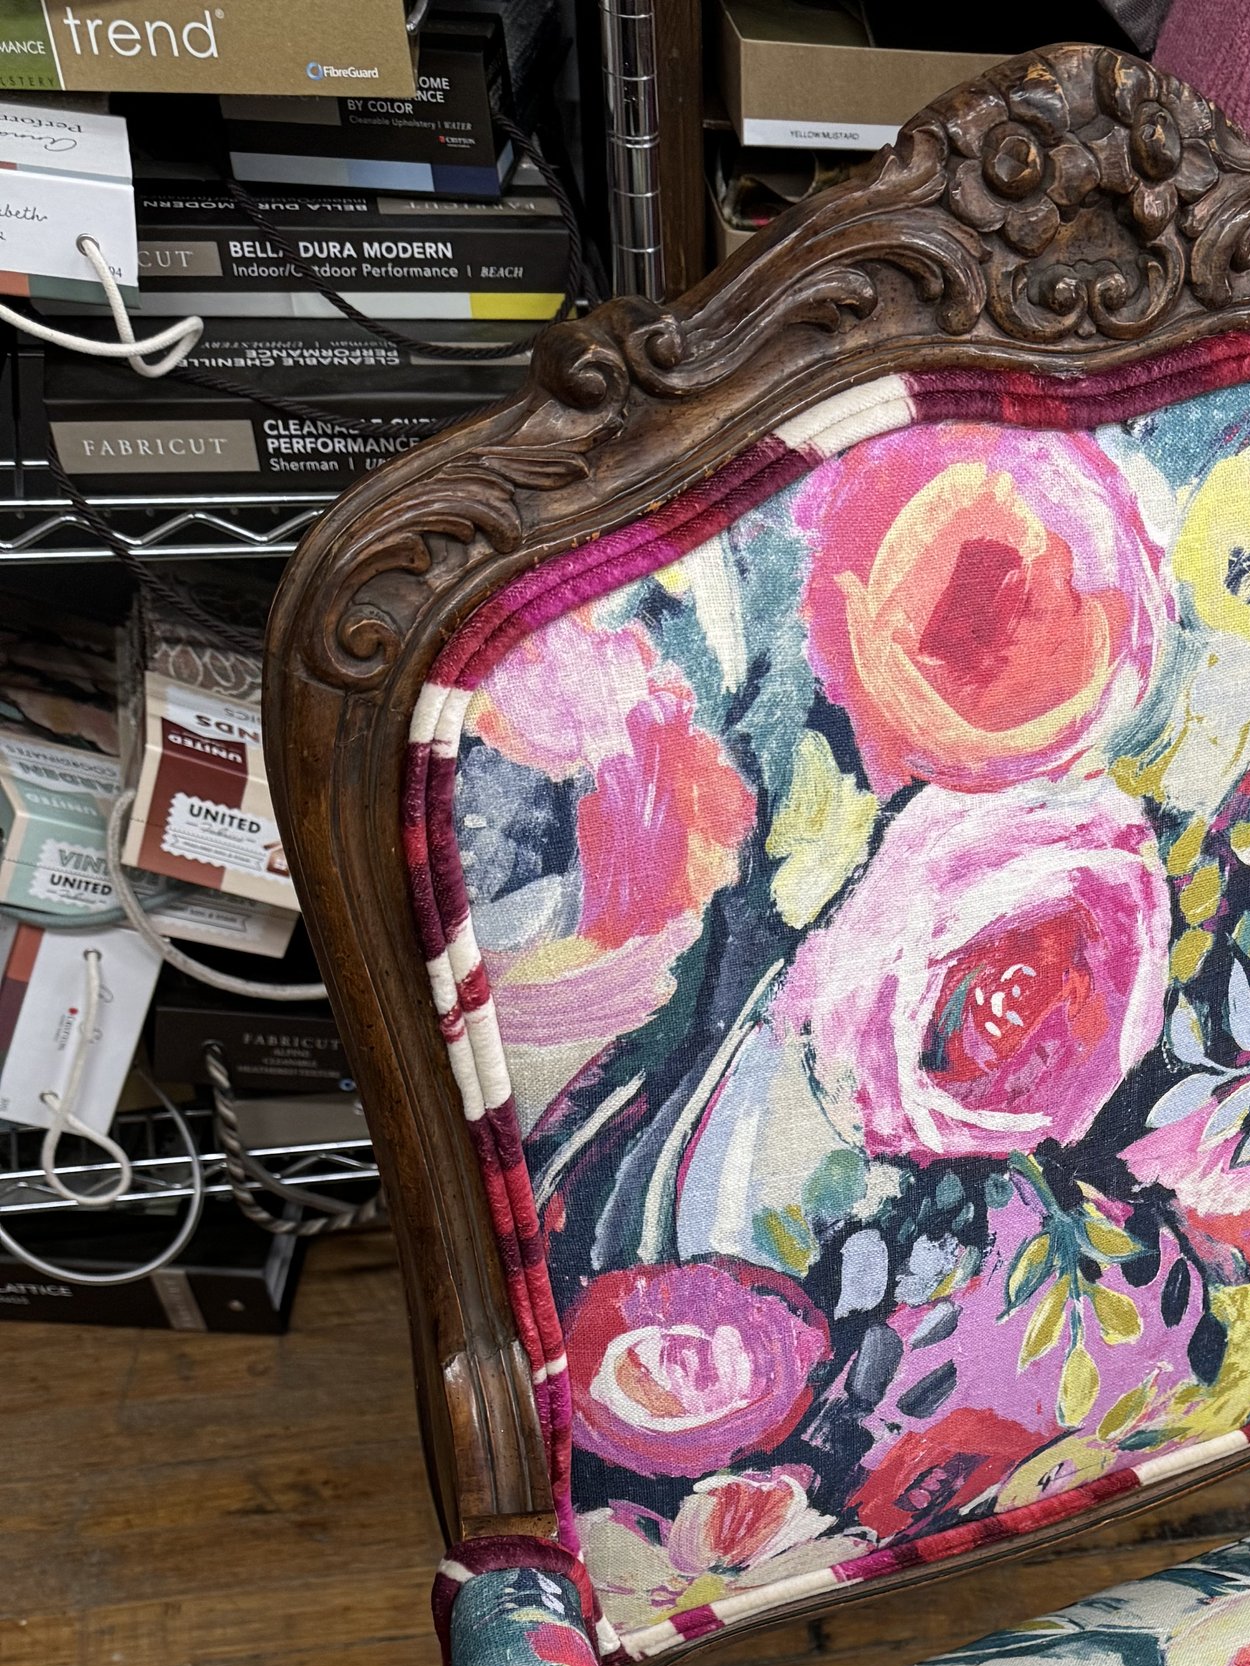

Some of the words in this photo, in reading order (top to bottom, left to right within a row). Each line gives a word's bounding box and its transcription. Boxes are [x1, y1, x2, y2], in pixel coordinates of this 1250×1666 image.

[63, 6, 219, 58] trend
[323, 65, 379, 79] FibreGuard
[415, 76, 450, 90] OME
[347, 100, 363, 111] BY
[368, 101, 414, 115] COLOR
[392, 118, 436, 131] Upholstery
[790, 130, 820, 139] YELLOW
[822, 131, 860, 141] MUSTARD
[258, 202, 300, 211] DUR
[229, 240, 284, 258] BELL
[299, 241, 358, 259] DURA
[362, 241, 454, 260] MODERN
[362, 262, 459, 278] Performance
[480, 265, 524, 279] BEACH
[245, 348, 399, 359] PERFORMANCE
[282, 356, 400, 367] CLEANABLE
[83, 437, 227, 457] FABRICUT
[269, 456, 340, 473] Sherman
[167, 733, 243, 764] UNITED
[189, 804, 262, 834] UNITED
[50, 873, 113, 896] UNITED
[242, 1032, 342, 1051] FABRICUT
